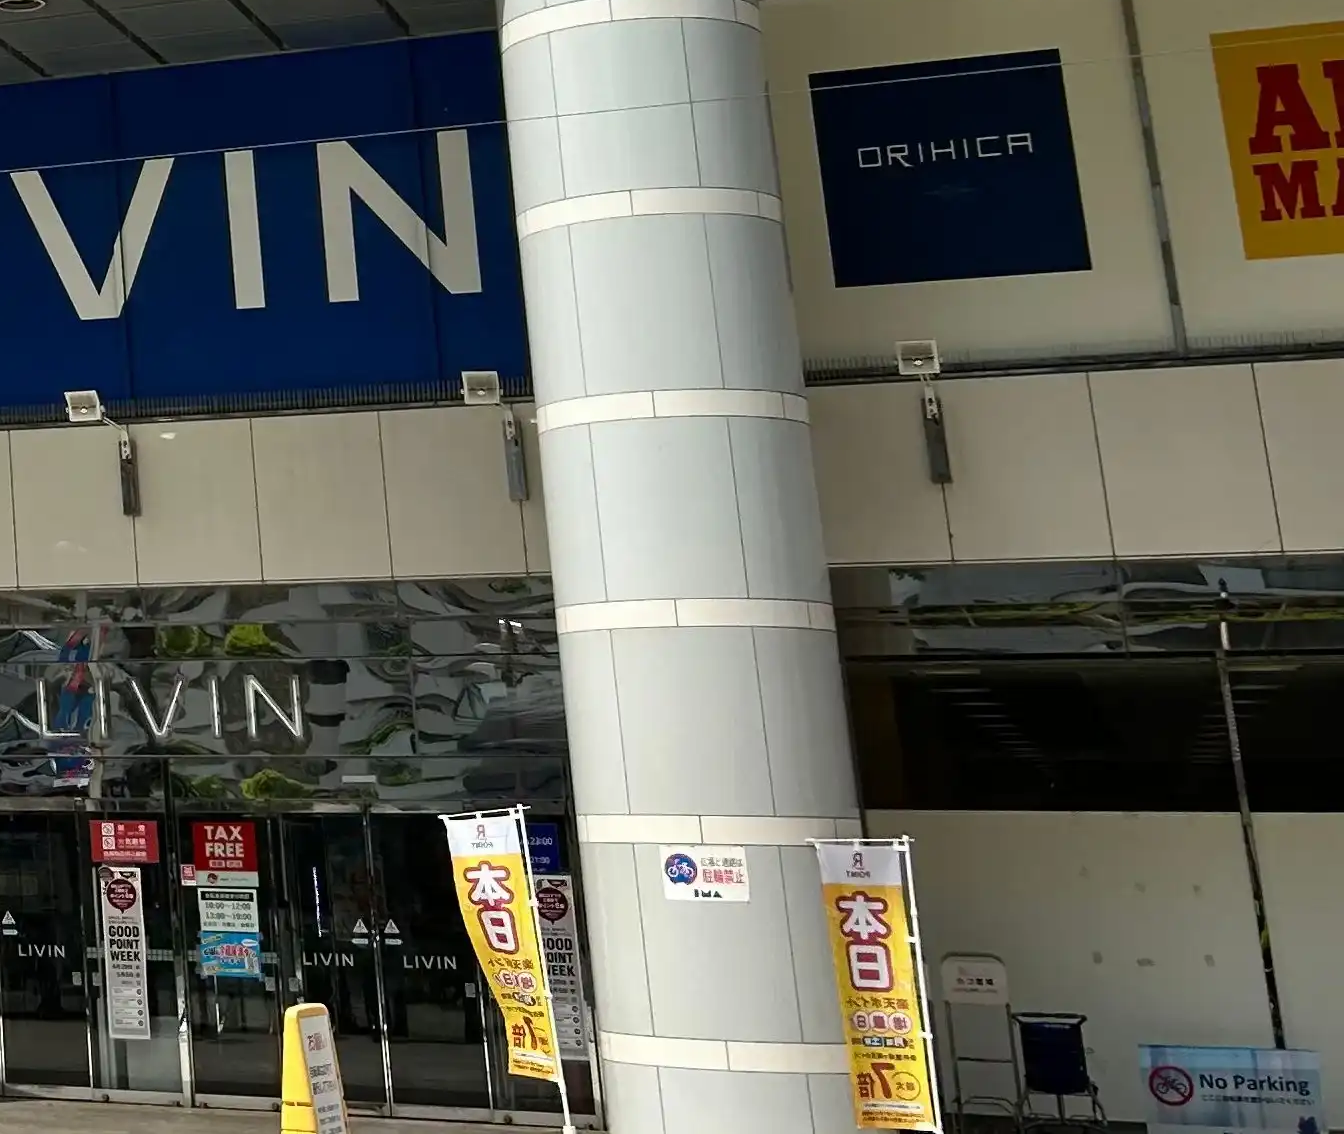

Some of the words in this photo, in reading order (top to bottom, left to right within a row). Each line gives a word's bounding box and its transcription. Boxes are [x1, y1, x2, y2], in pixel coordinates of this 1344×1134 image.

[1249, 60, 1344, 154] A
[858, 133, 1033, 167] ORIHICA
[1253, 158, 1344, 221] M
[36, 674, 304, 740] LIVIN
[204, 825, 243, 841] TAX
[205, 842, 244, 858] FREE
[463, 861, 518, 954] 本日
[109, 926, 140, 937] GOOD
[110, 939, 140, 949] POINT
[835, 891, 894, 992] 本日
[18, 943, 66, 958] LIVIN
[110, 951, 141, 962] WEEK
[544, 953, 573, 964] OINT
[302, 952, 354, 968] LIVIN
[403, 955, 457, 970] LIVIN
[1199, 1074, 1227, 1090] No
[1233, 1075, 1311, 1096] Parking
